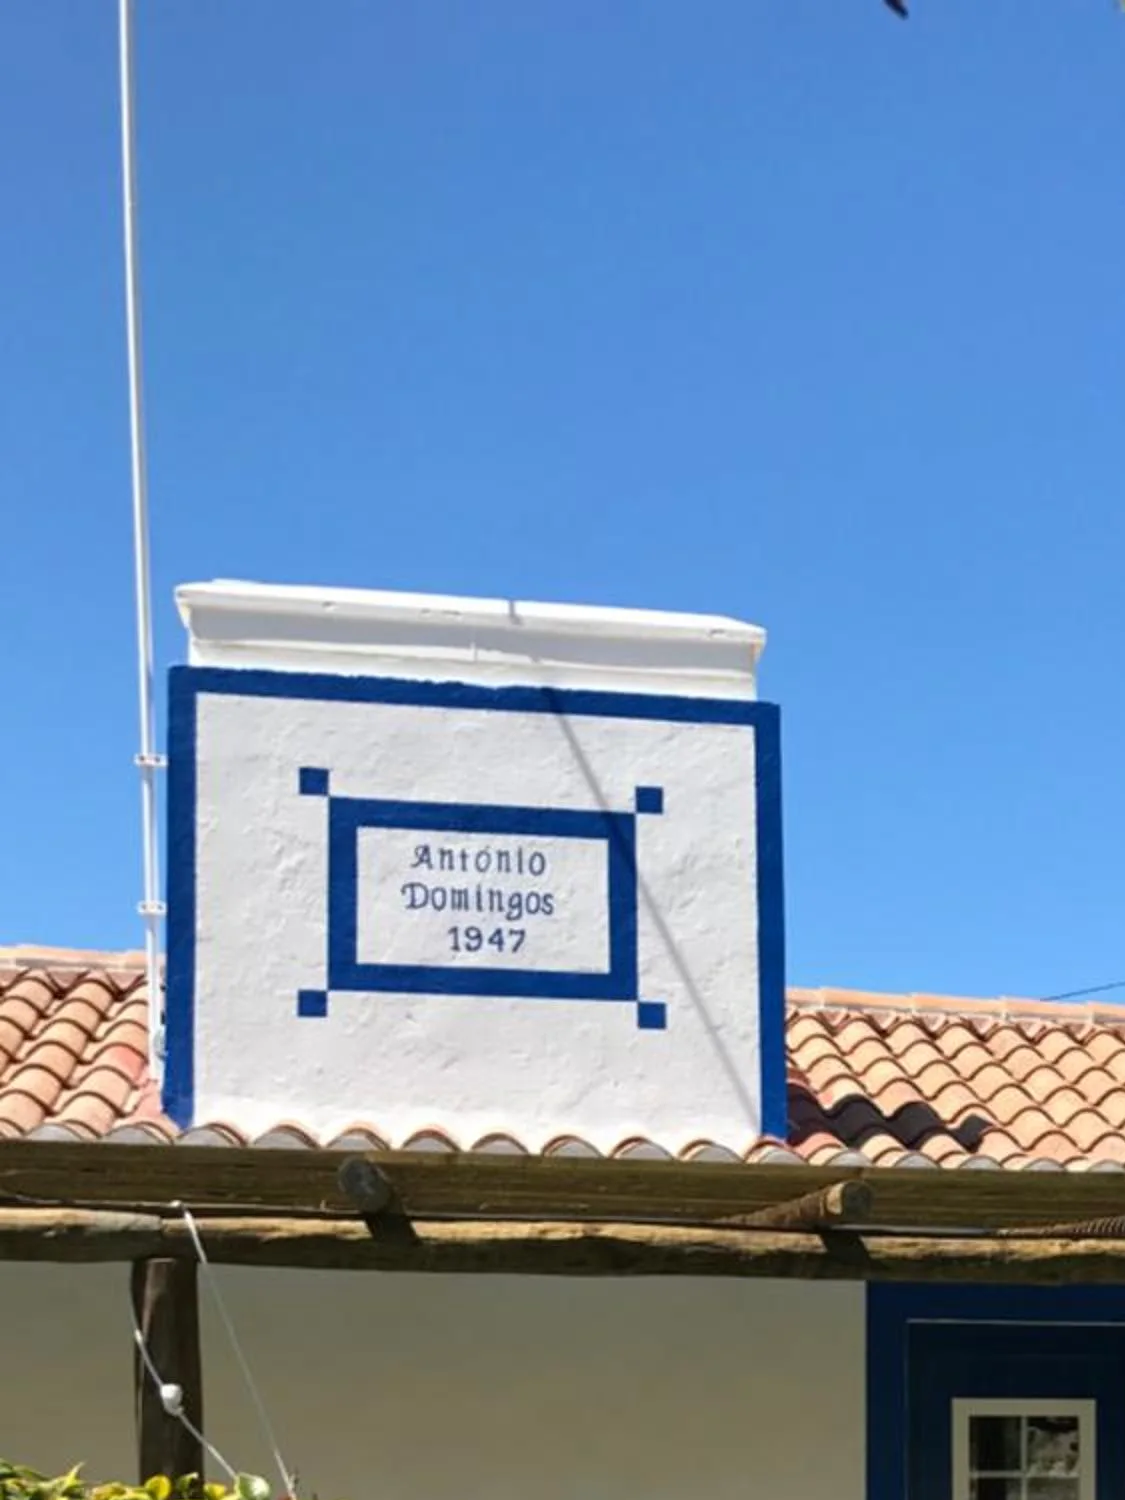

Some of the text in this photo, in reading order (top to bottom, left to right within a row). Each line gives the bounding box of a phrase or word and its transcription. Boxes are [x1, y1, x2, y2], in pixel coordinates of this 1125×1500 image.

[410, 843, 547, 877] António
[400, 881, 555, 922] Domingos
[447, 925, 527, 953] 1947
